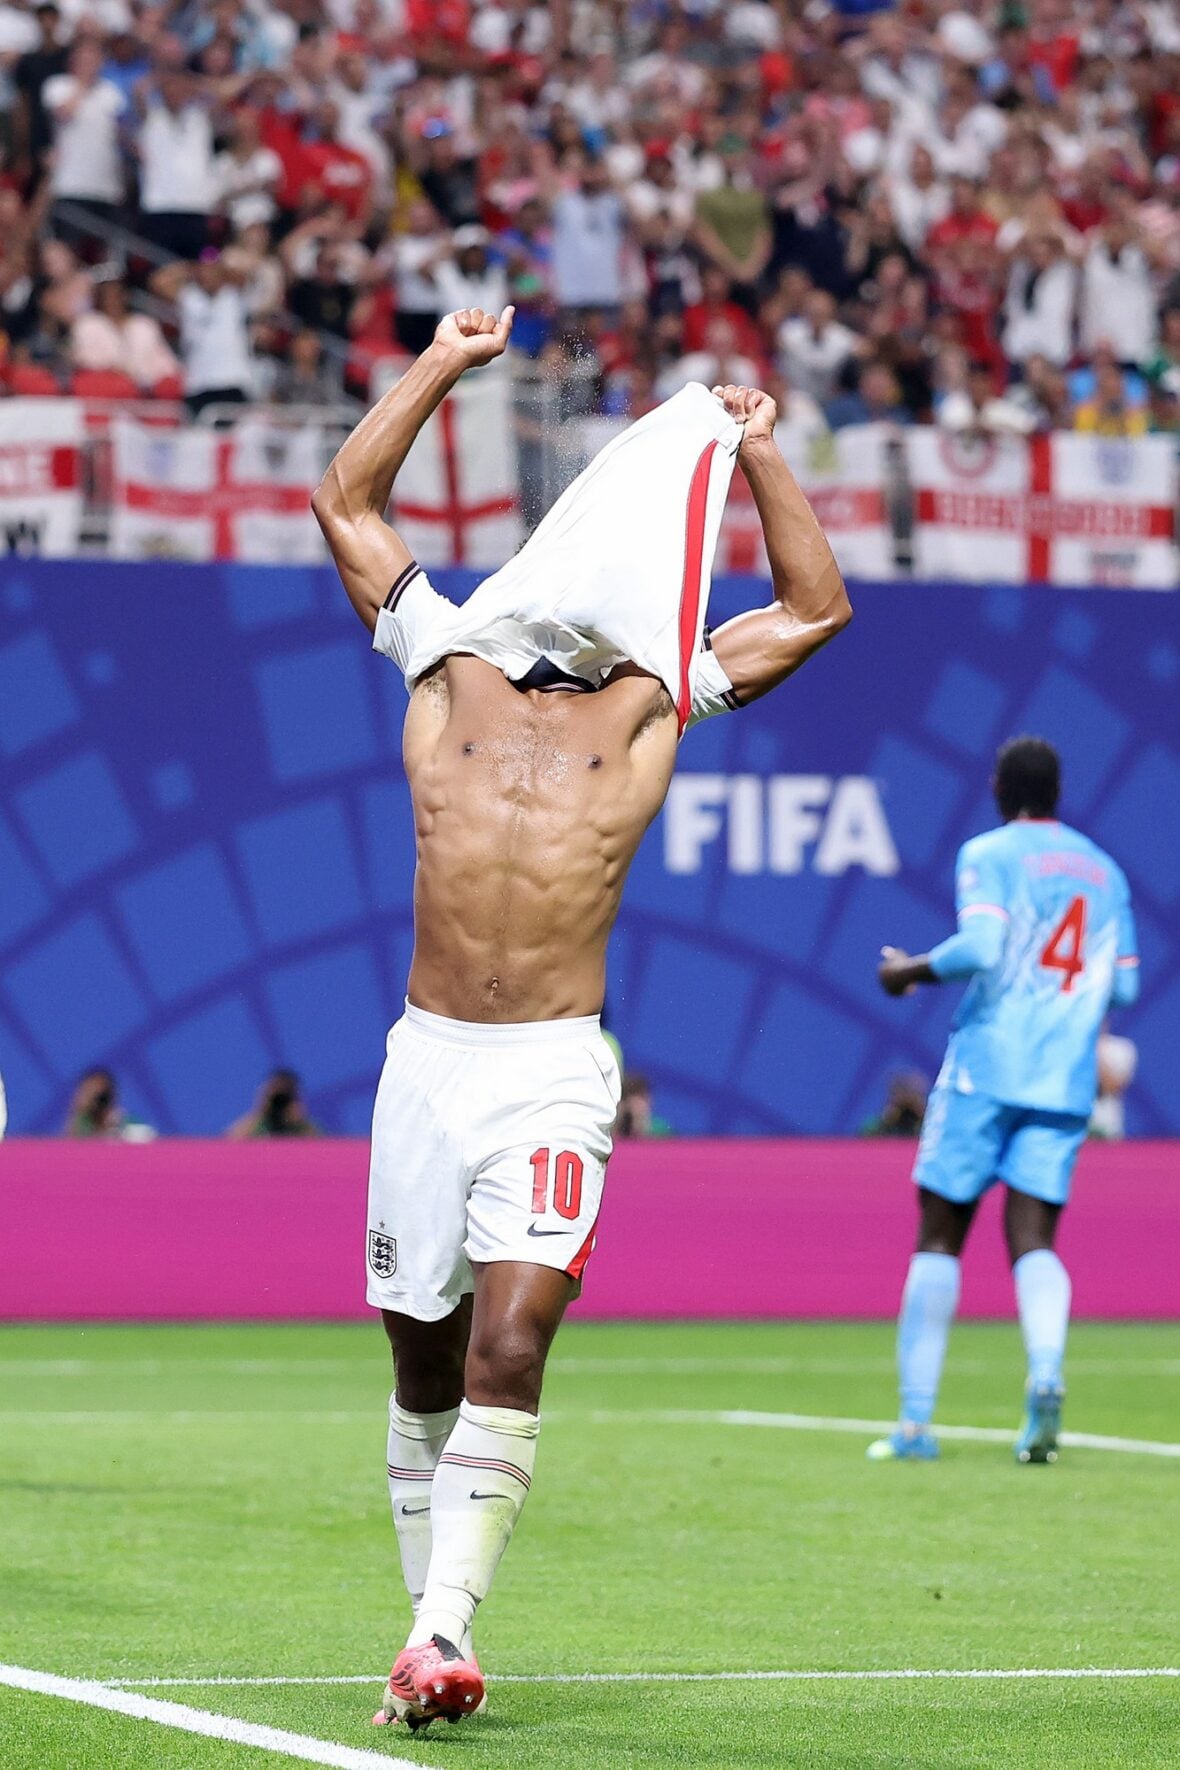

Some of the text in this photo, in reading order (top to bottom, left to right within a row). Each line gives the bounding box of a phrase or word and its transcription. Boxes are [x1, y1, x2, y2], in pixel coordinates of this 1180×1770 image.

[664, 775, 899, 876] FIFA
[1039, 893, 1087, 993] 4
[529, 1147, 584, 1220] 10
